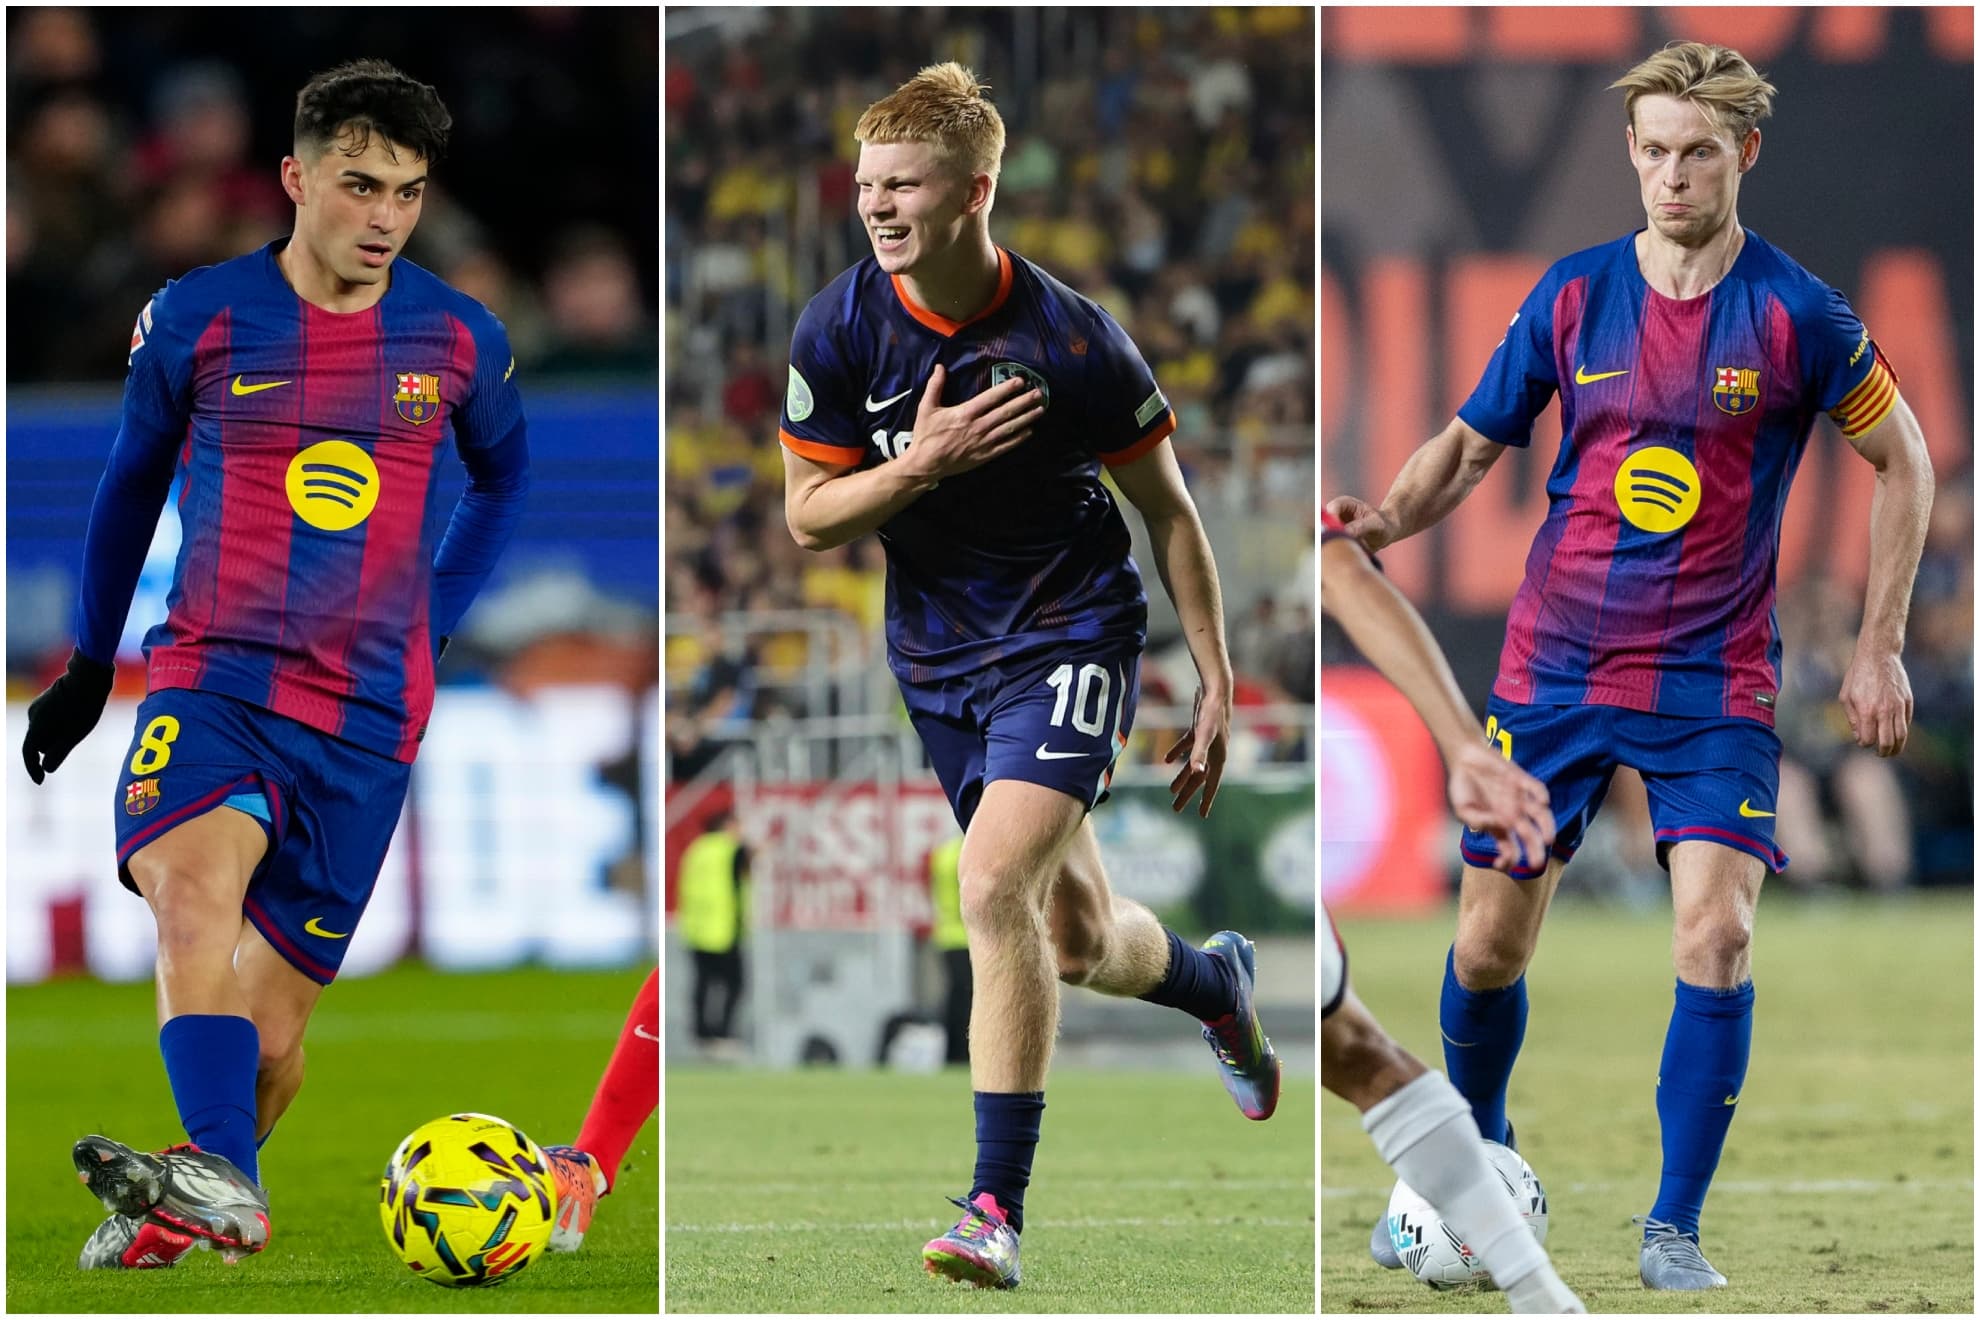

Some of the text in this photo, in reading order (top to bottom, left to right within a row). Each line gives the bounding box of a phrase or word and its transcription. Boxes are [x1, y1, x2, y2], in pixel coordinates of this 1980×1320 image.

[871, 429, 914, 462] 1
[1046, 663, 1111, 738] 10
[130, 715, 180, 776] 8
